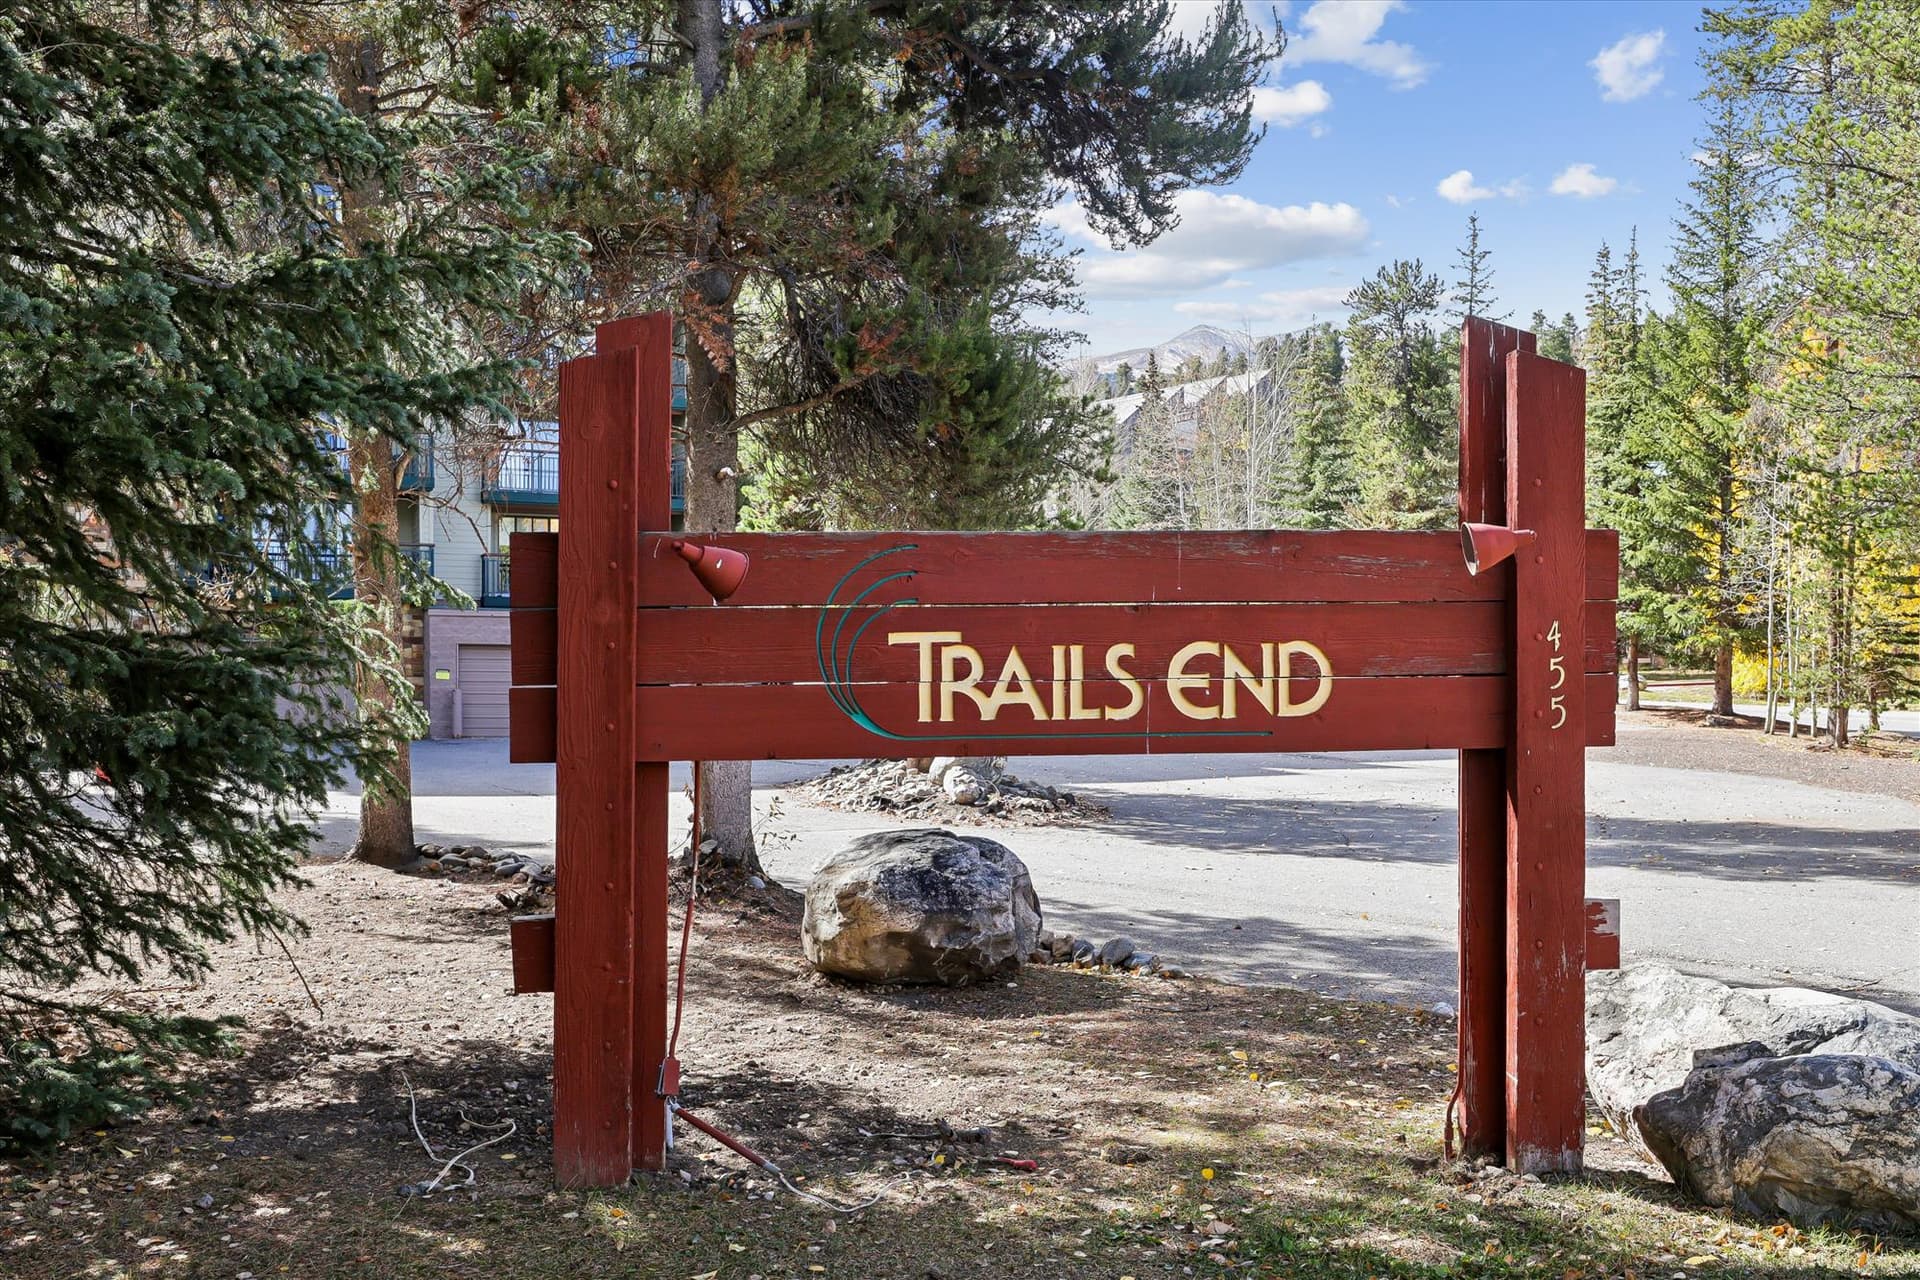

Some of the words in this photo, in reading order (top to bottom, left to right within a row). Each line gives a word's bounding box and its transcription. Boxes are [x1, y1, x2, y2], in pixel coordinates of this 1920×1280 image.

[887, 631, 1145, 723] TRAILS
[1166, 639, 1334, 720] END
[1546, 620, 1567, 729] 455
